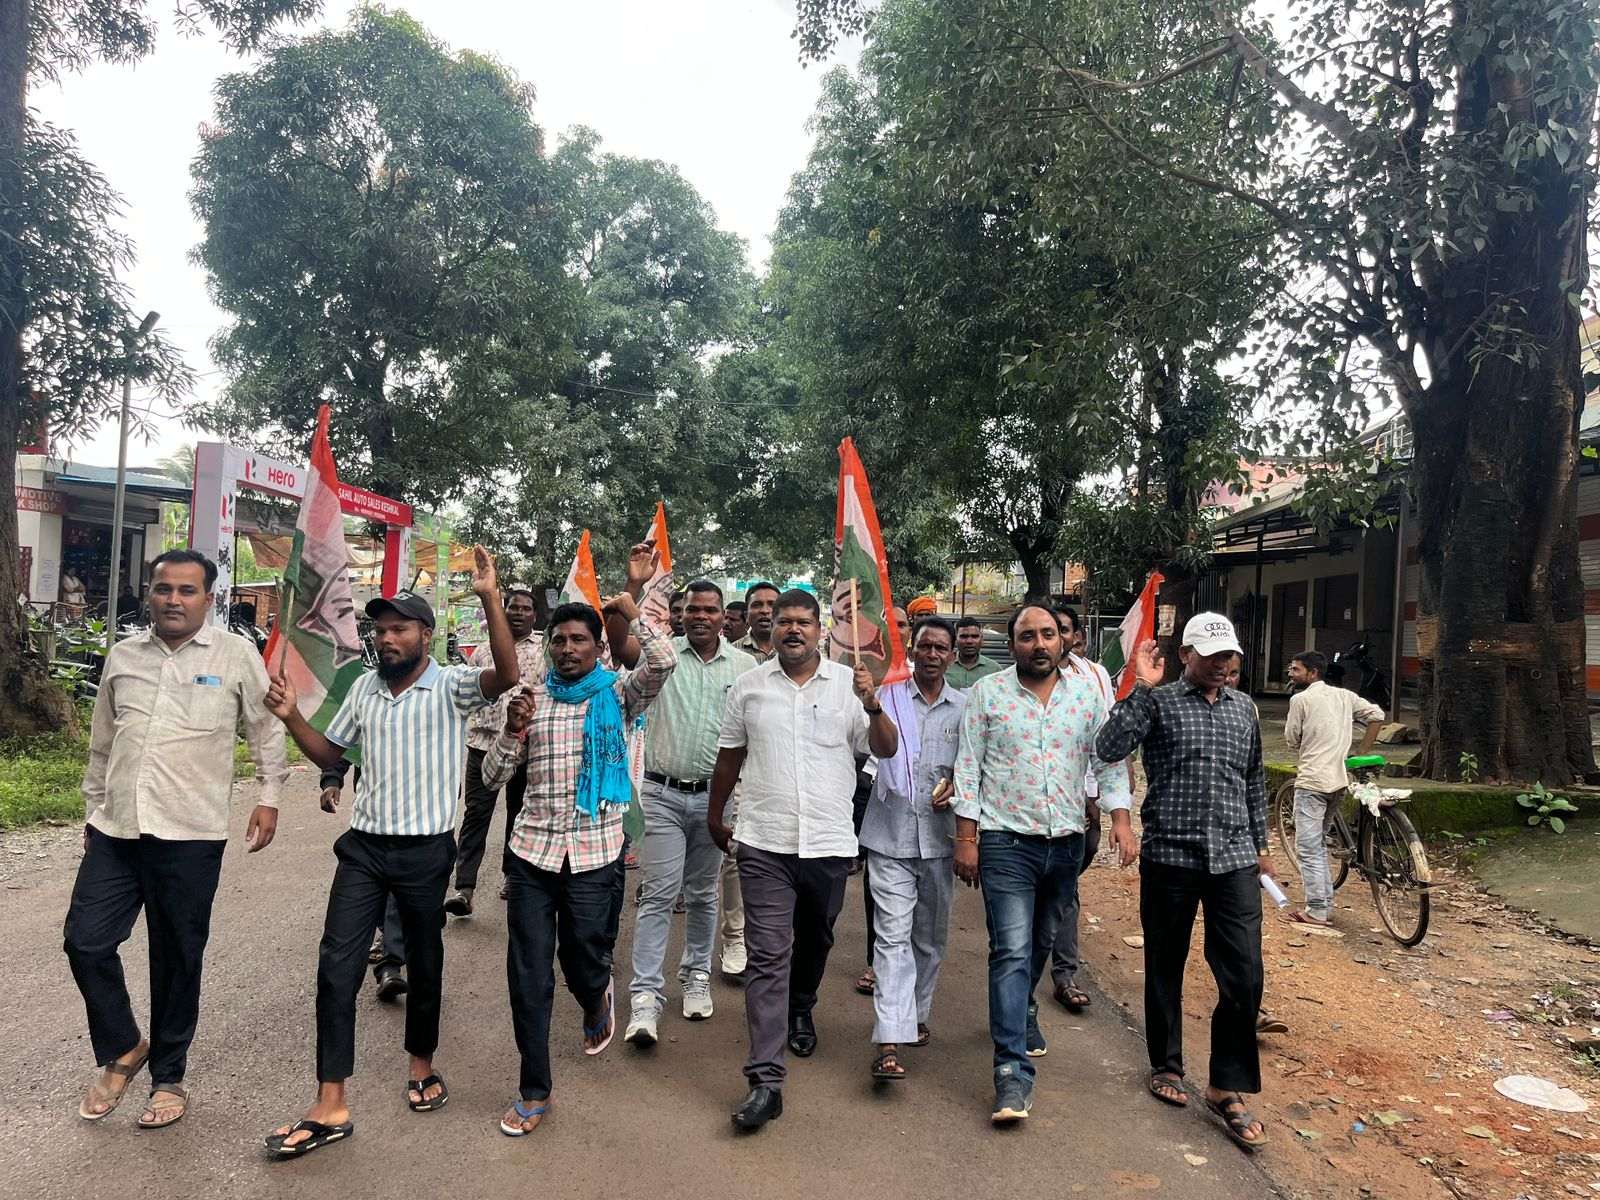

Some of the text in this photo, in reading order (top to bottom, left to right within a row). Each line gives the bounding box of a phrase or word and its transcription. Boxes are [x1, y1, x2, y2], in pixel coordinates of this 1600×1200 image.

[268, 467, 295, 488] Hero
[17, 487, 62, 502] MOTIVE
[353, 493, 367, 506] AUTO
[367, 497, 380, 510] SALES
[28, 500, 57, 512] SHOP
